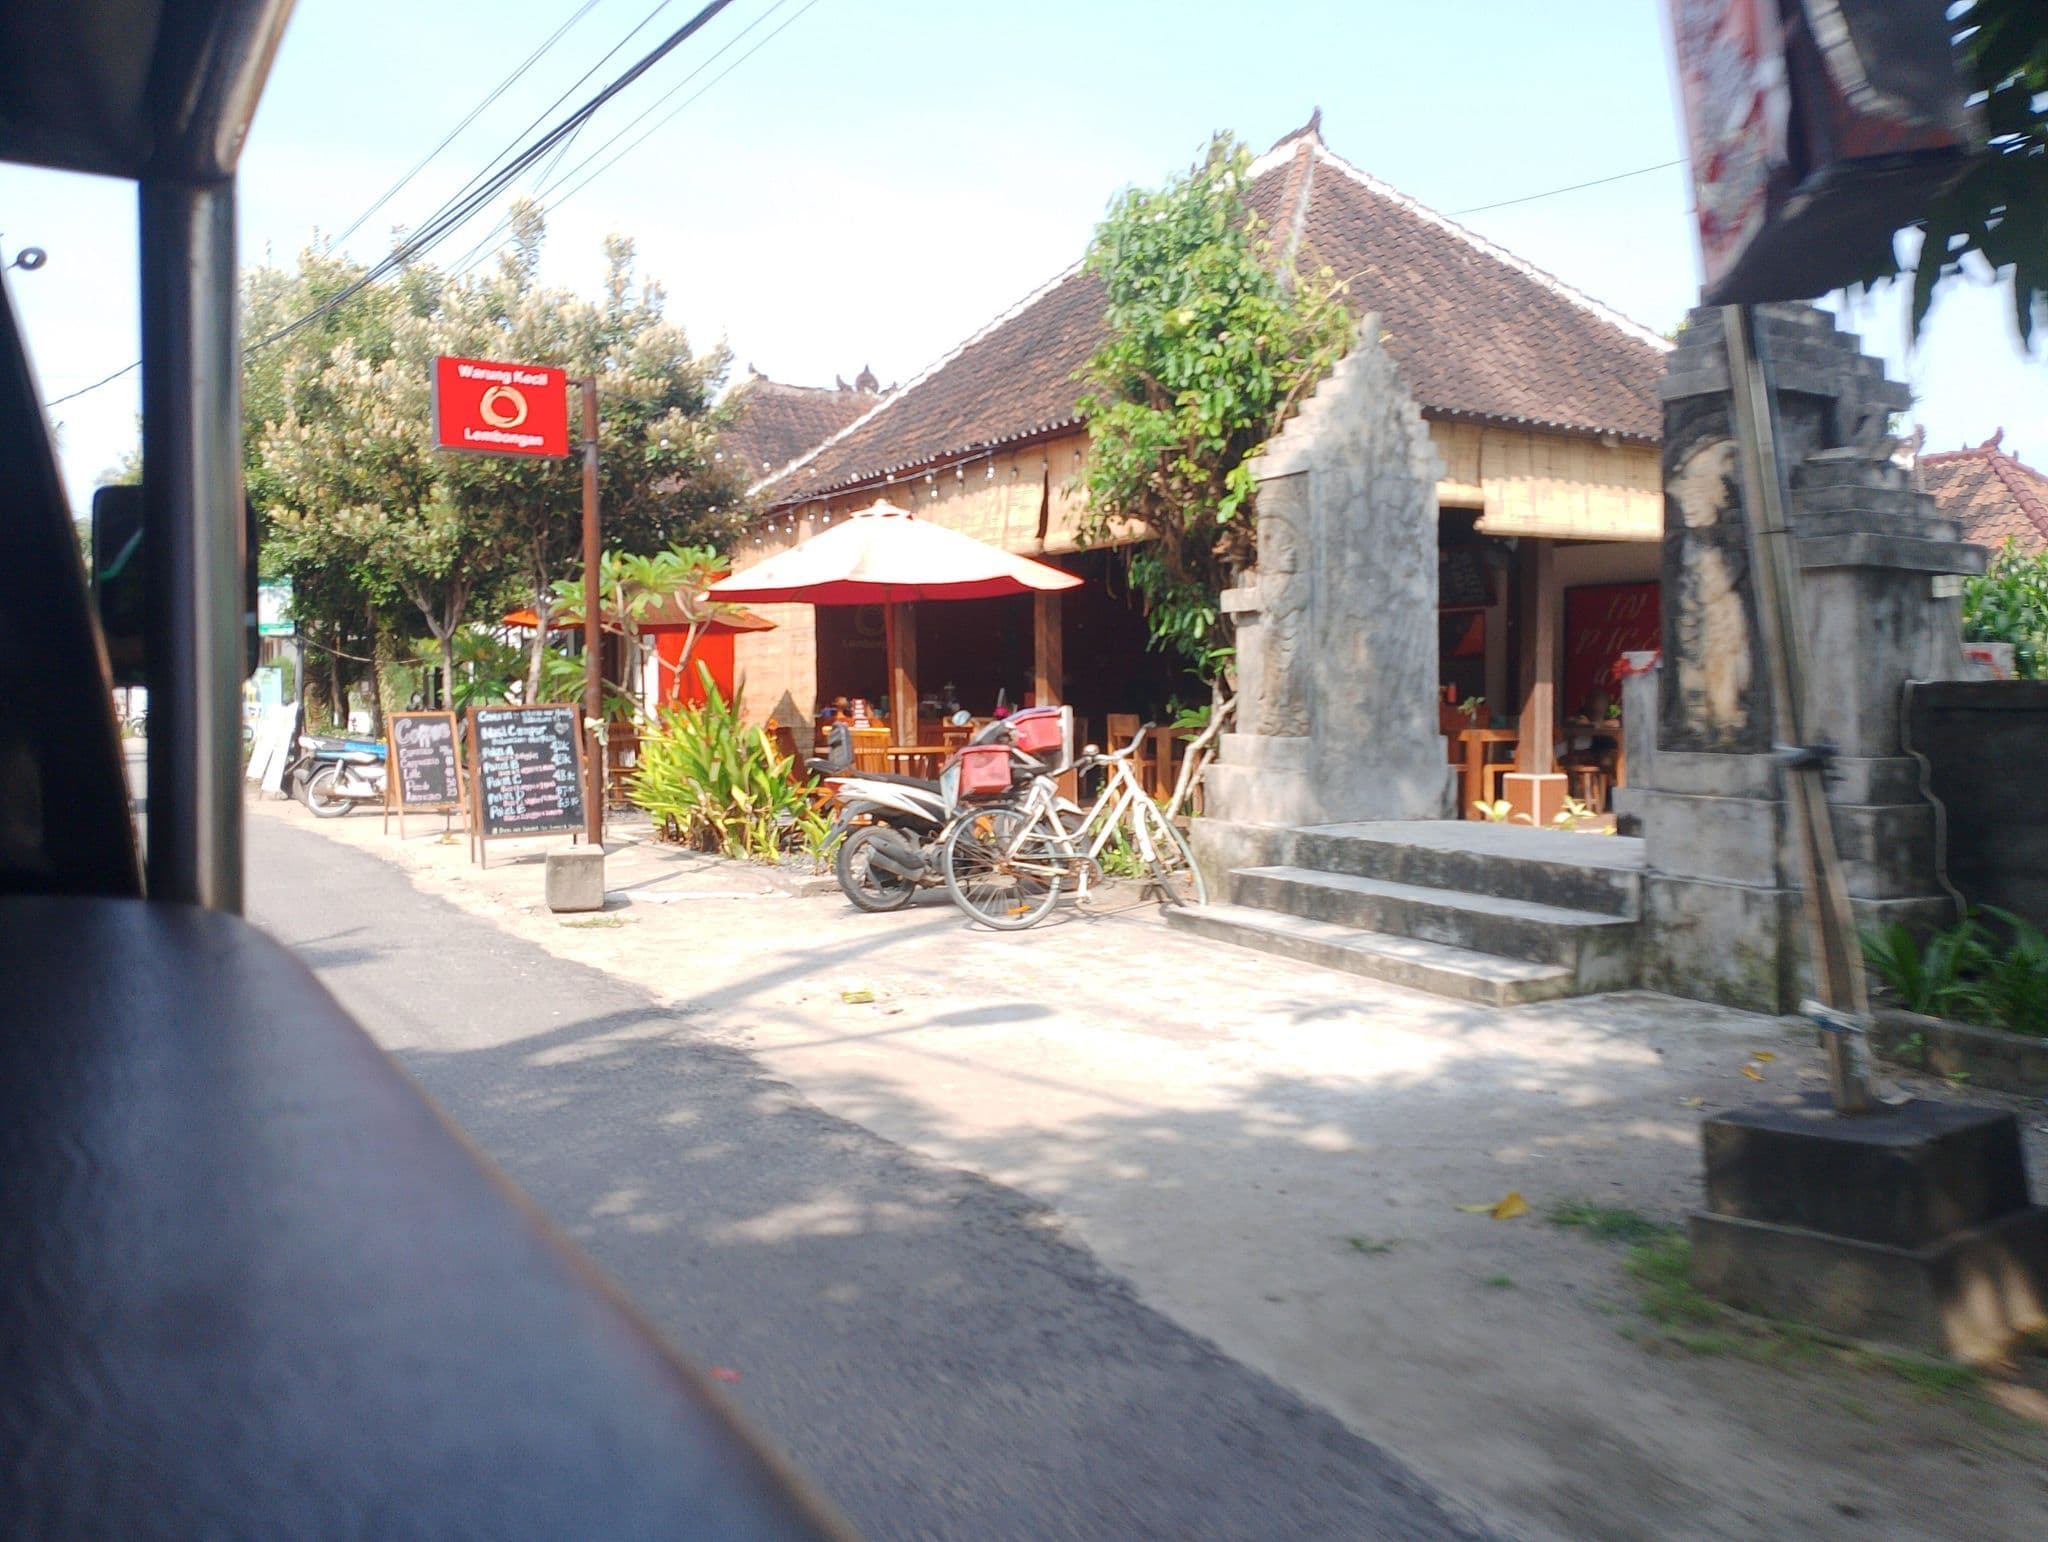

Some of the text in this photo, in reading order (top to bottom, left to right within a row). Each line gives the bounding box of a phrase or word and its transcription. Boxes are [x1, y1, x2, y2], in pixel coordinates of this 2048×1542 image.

[458, 364, 549, 386] Warung Kecil
[464, 427, 545, 448] Lembongan
